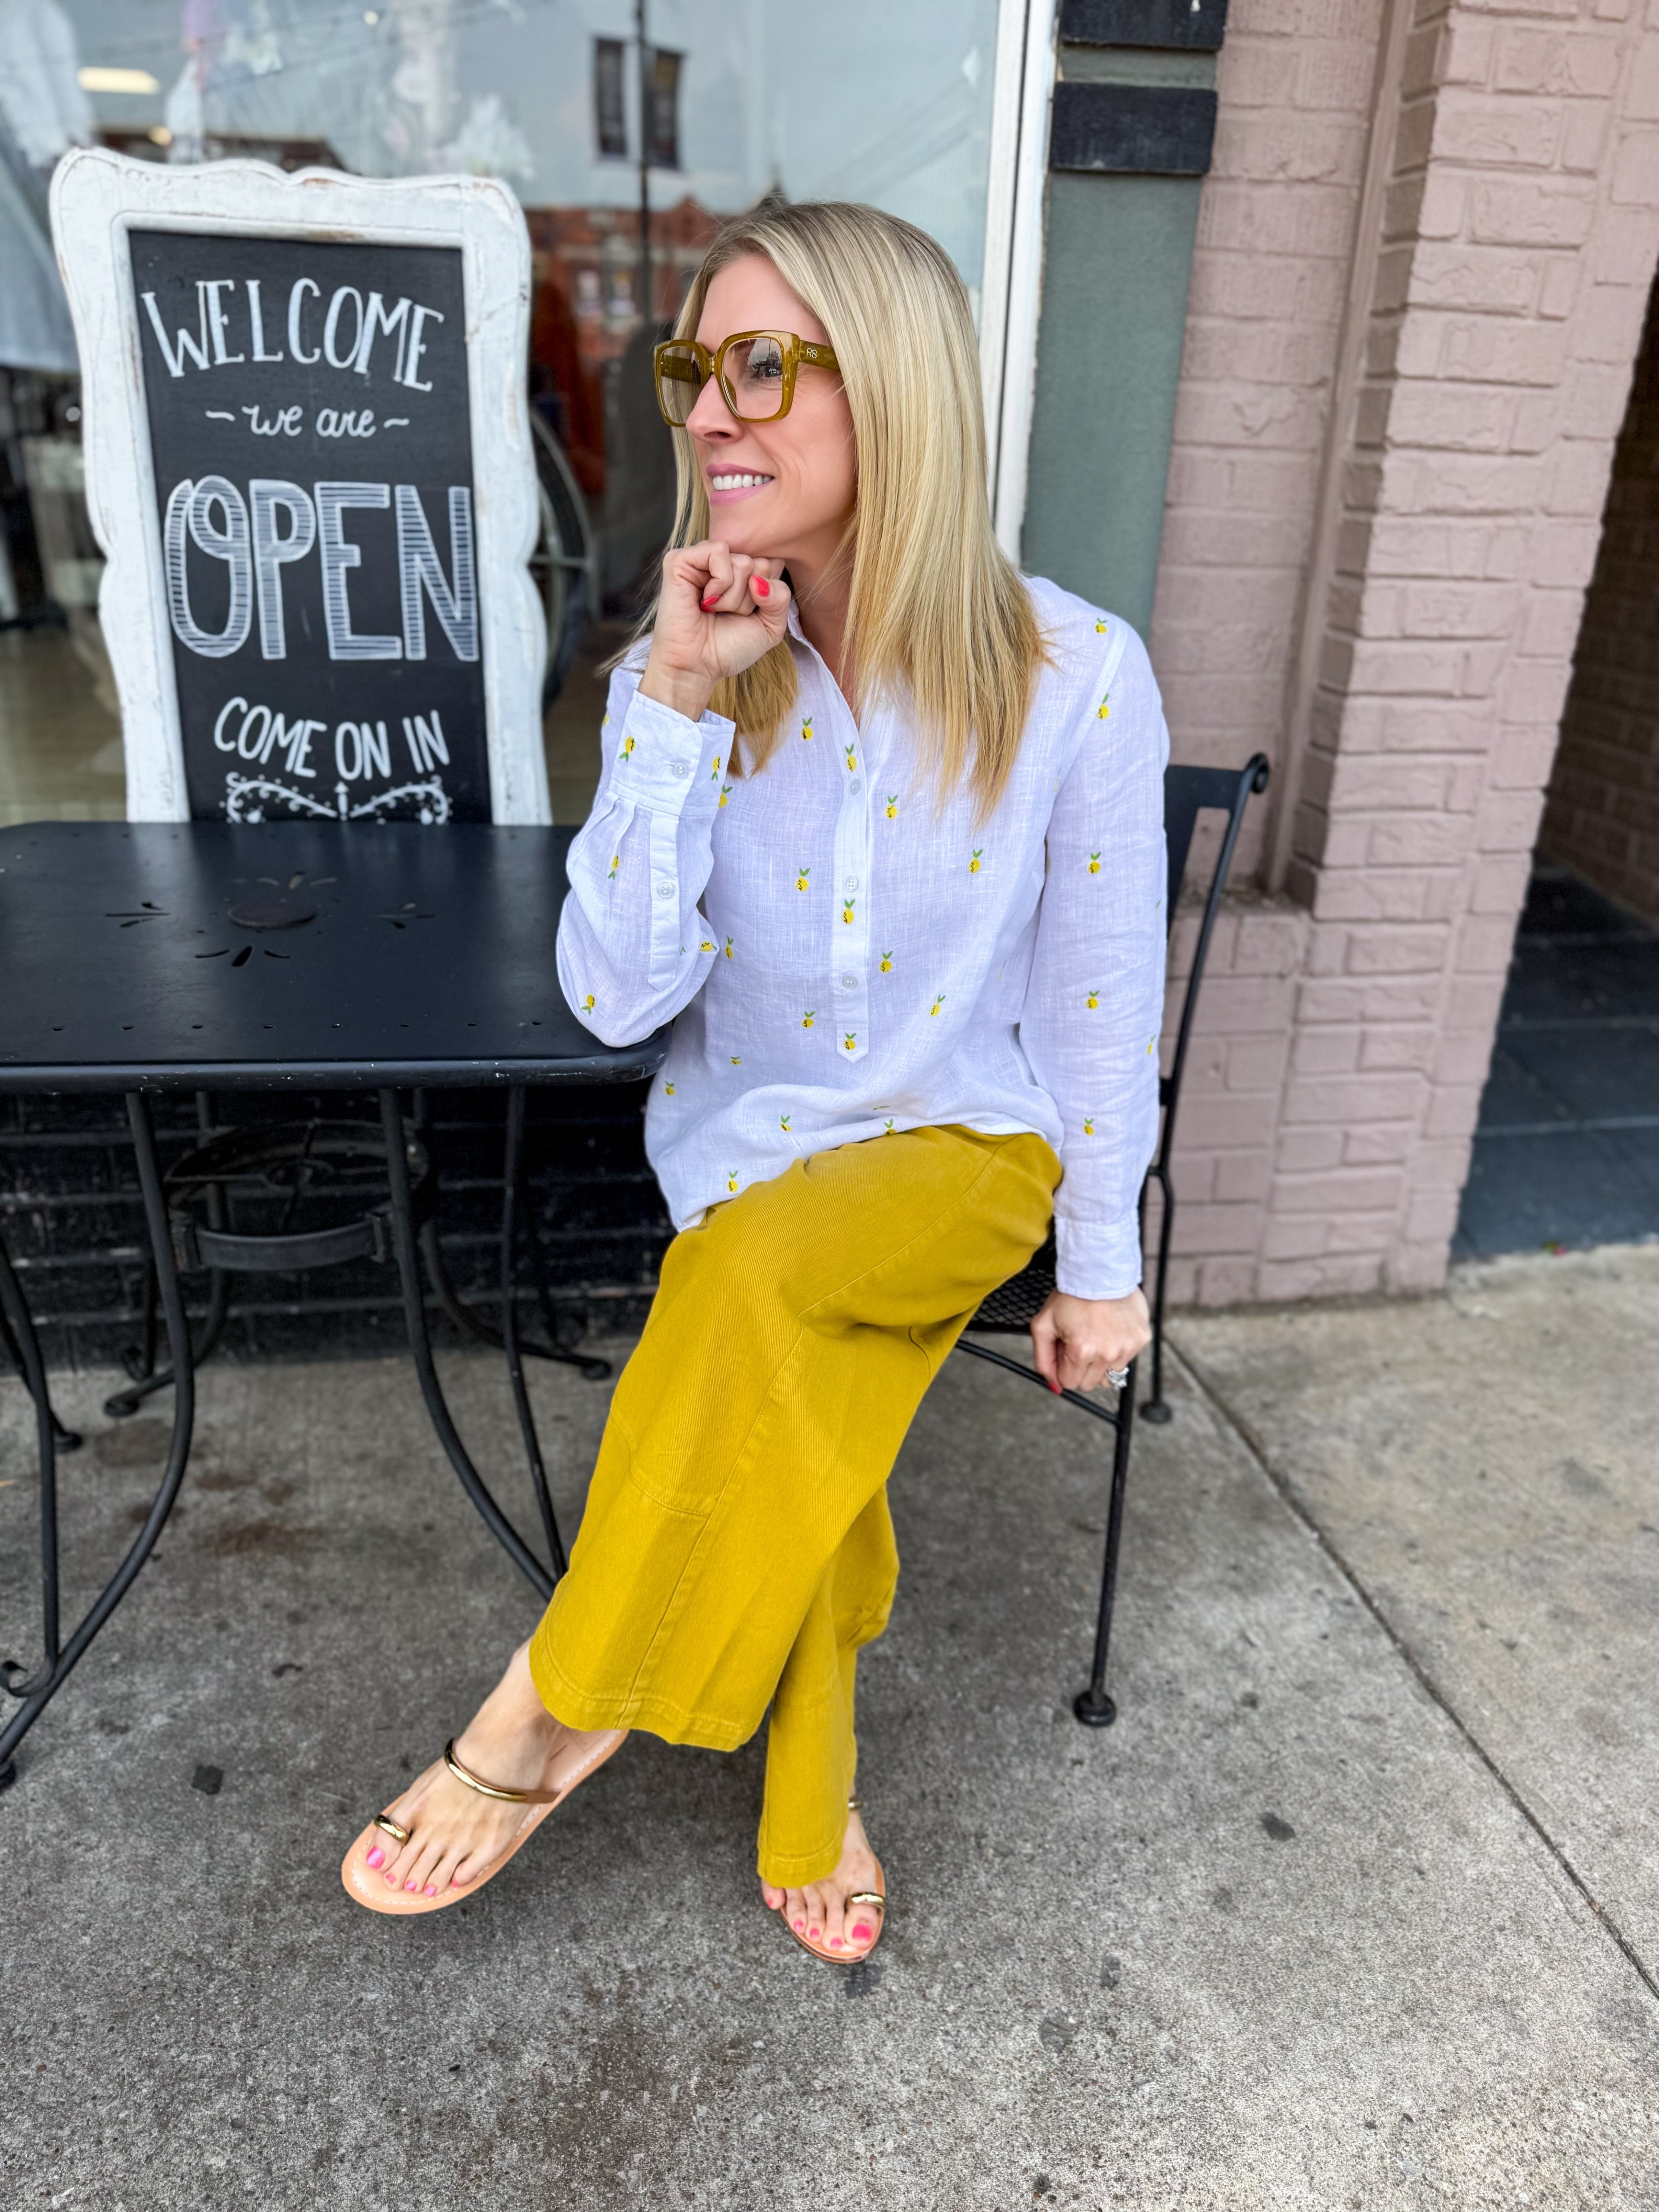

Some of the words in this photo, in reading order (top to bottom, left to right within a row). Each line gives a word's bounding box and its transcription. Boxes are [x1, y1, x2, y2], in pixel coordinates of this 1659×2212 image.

[142, 278, 444, 391] WELCOME
[806, 348, 817, 359] RS
[242, 405, 303, 437] we
[316, 408, 377, 438] are
[164, 475, 479, 661] OPEN
[214, 696, 327, 778] COME
[335, 721, 391, 781] ON
[402, 710, 450, 774] IN
